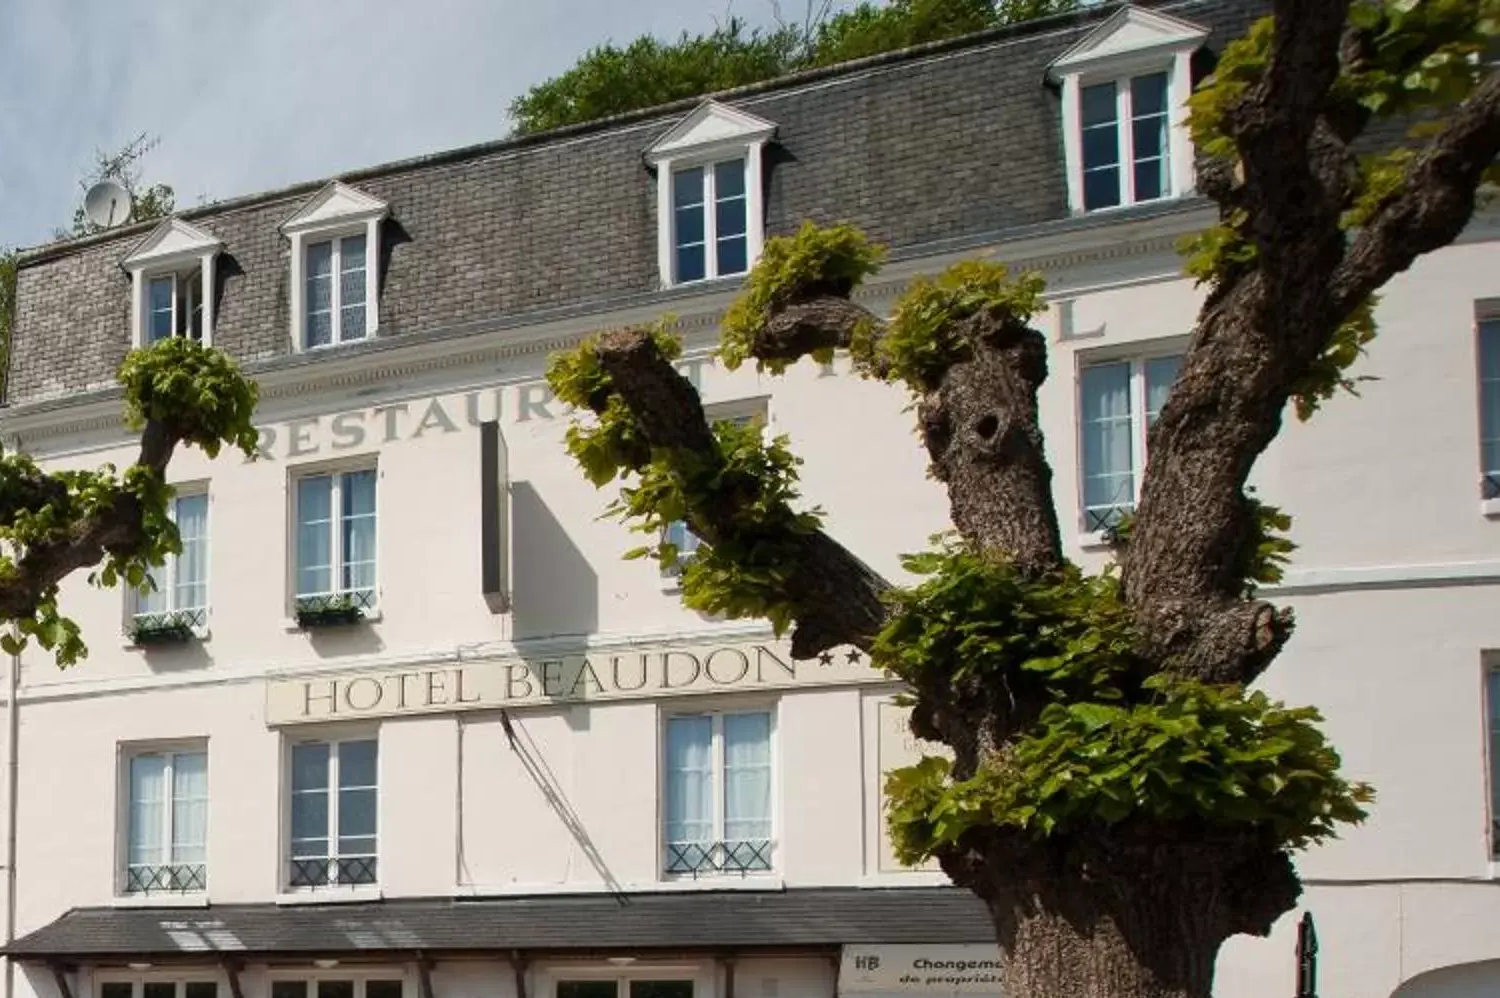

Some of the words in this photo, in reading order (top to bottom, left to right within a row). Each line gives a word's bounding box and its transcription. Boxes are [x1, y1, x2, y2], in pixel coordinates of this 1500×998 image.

[303, 669, 481, 715] HOTEL
[503, 645, 796, 699] BEAUDON
[855, 955, 880, 971] HB
[912, 958, 1005, 971] Changeme
